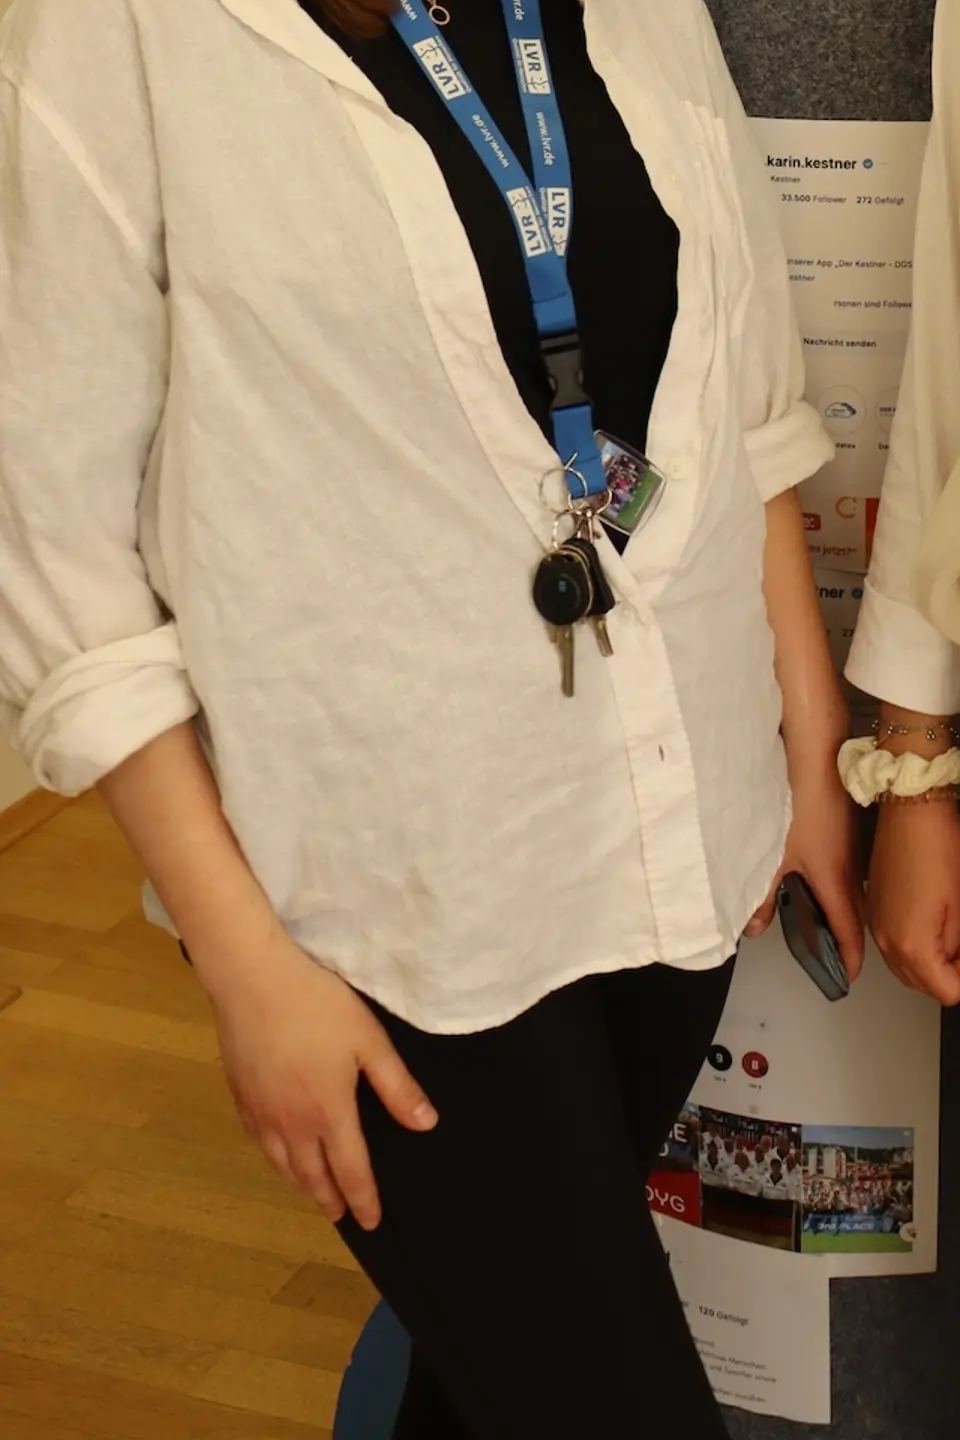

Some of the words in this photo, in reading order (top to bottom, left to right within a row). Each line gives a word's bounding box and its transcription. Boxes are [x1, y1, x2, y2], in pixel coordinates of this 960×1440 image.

[523, 42, 541, 72] LVR
[432, 62, 459, 96] LVR
[471, 114, 509, 168] www.lvr.de
[536, 111, 554, 166] www.lvr.de
[767, 156, 857, 169] karin.kestner
[770, 175, 801, 183] Kestner
[551, 192, 565, 227] LVR
[781, 194, 811, 202] 33.500
[812, 195, 847, 203] Follower
[857, 196, 872, 204] 272
[875, 197, 904, 205] Gefolgt
[521, 215, 541, 252] LVR
[803, 338, 843, 347] Nachricht
[846, 340, 876, 348] senden
